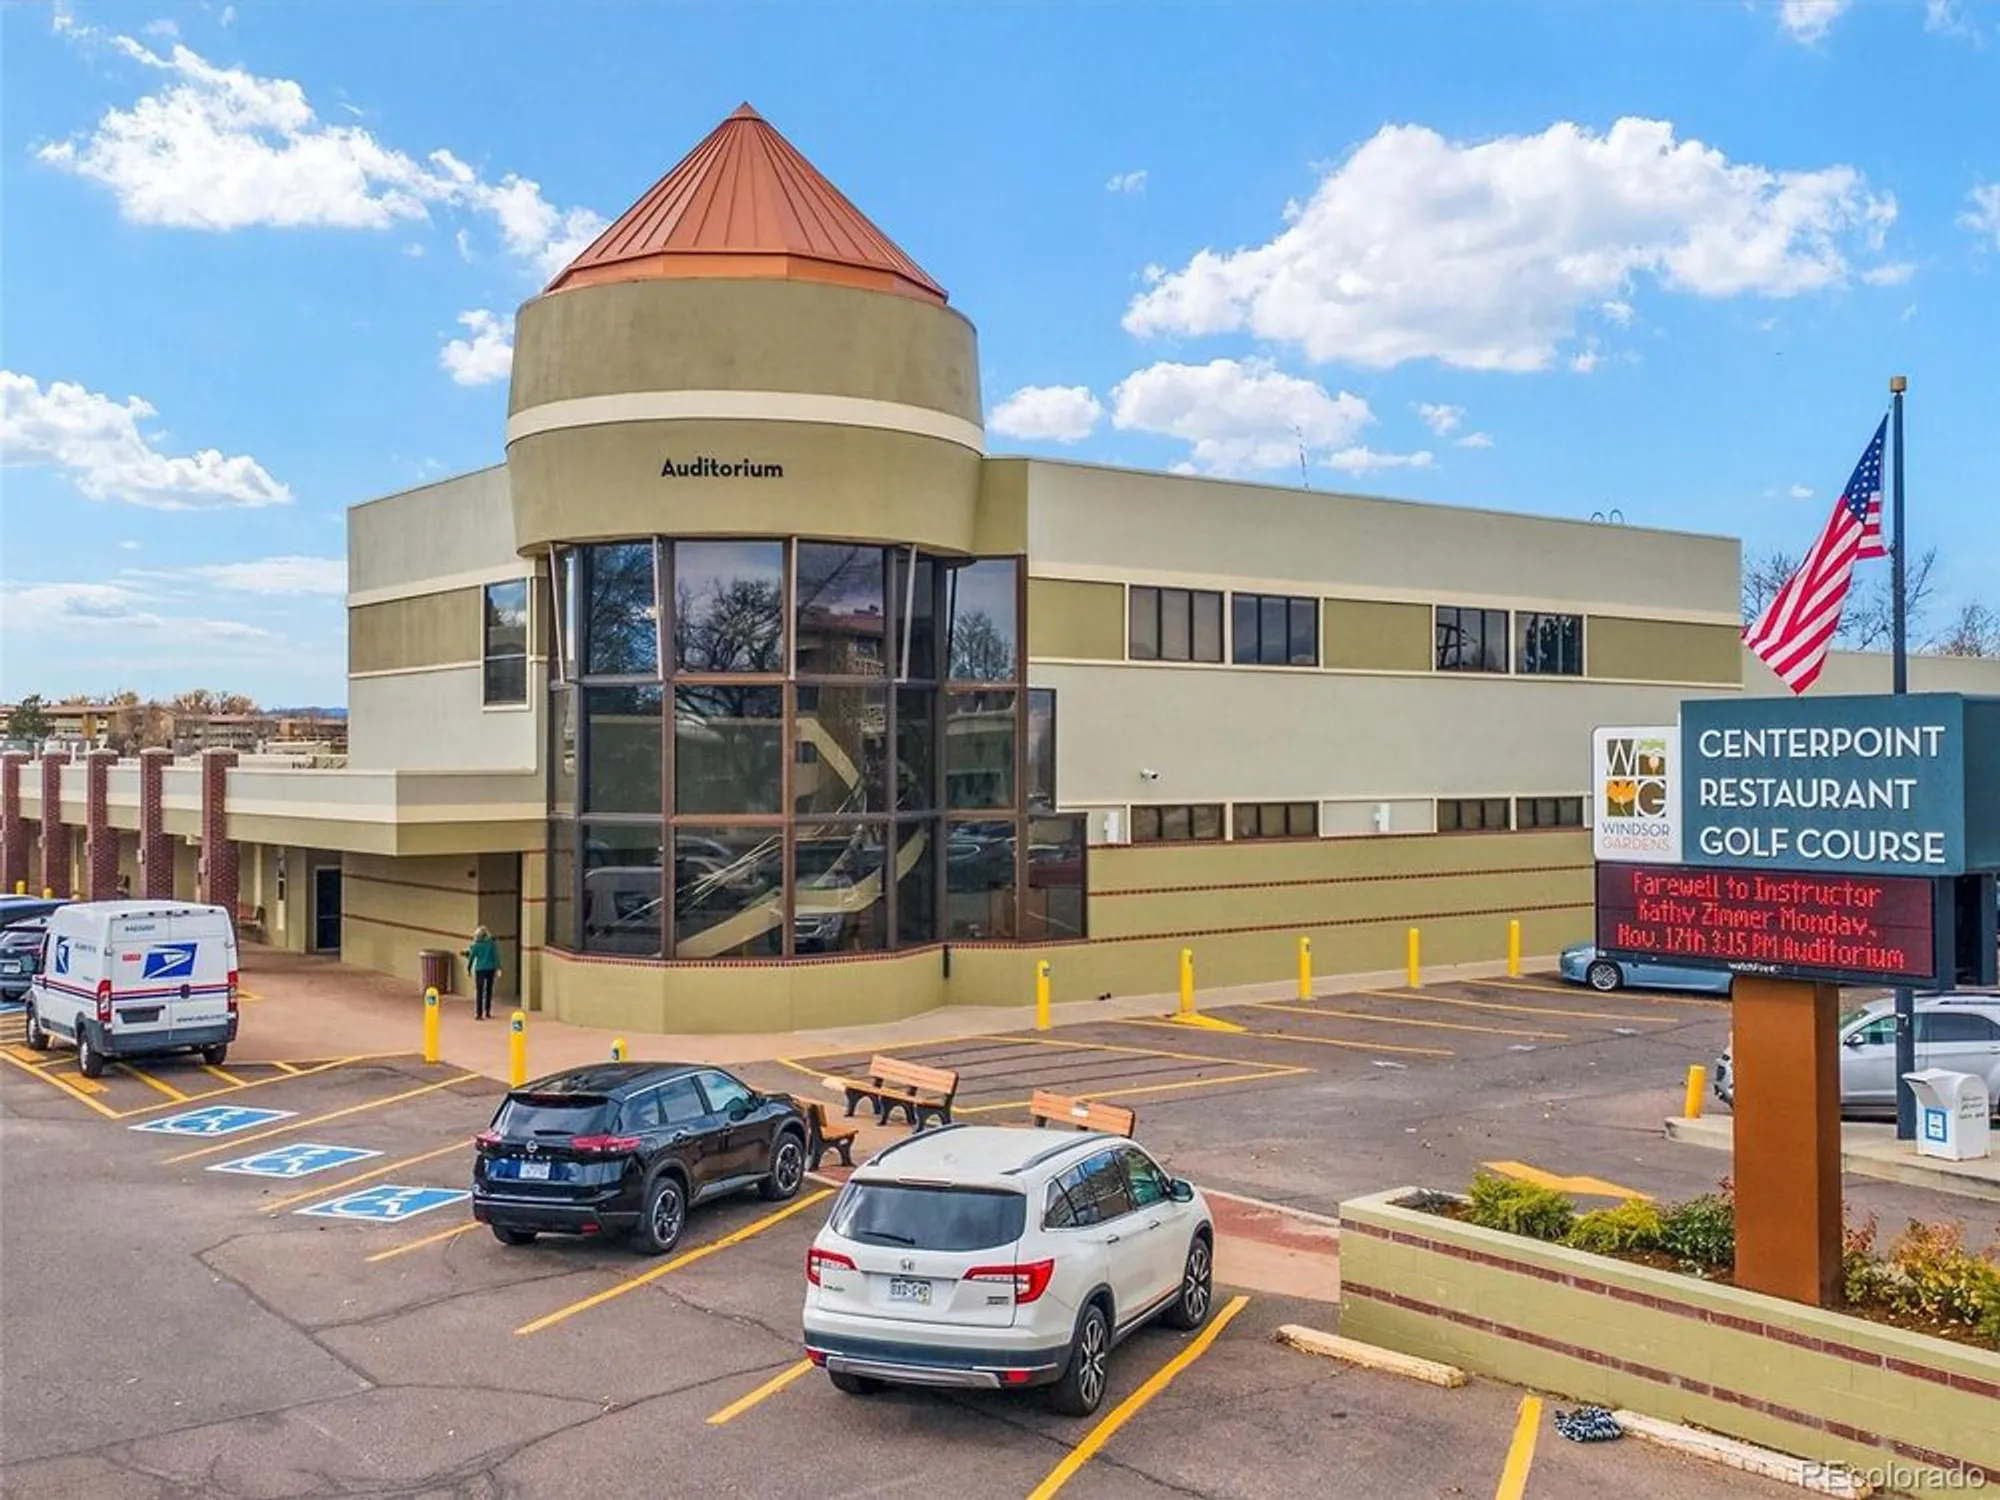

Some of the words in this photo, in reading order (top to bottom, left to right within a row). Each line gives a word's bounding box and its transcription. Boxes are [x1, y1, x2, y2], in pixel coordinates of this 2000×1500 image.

[661, 456, 783, 477] Auditorium
[1699, 726, 1945, 758] CENTERPOINT
[1699, 778, 1917, 810] RESTAURANT
[1602, 821, 1671, 837] WINDSOR
[1602, 837, 1671, 852] GARDENS
[1699, 826, 1790, 859] GOLF
[1798, 829, 1945, 863] COURSE
[1633, 872, 1720, 898] Farewell
[1726, 875, 1748, 900] to
[1754, 877, 1882, 907] Instructor
[1638, 899, 1696, 924] Kathy
[1702, 902, 1774, 929] Zimmer
[1617, 922, 1661, 948] Nov.
[1666, 927, 1706, 951] 17th
[1712, 930, 1747, 956] 3:15
[1752, 932, 1777, 958] PM
[1784, 936, 1904, 969] Auditorium
